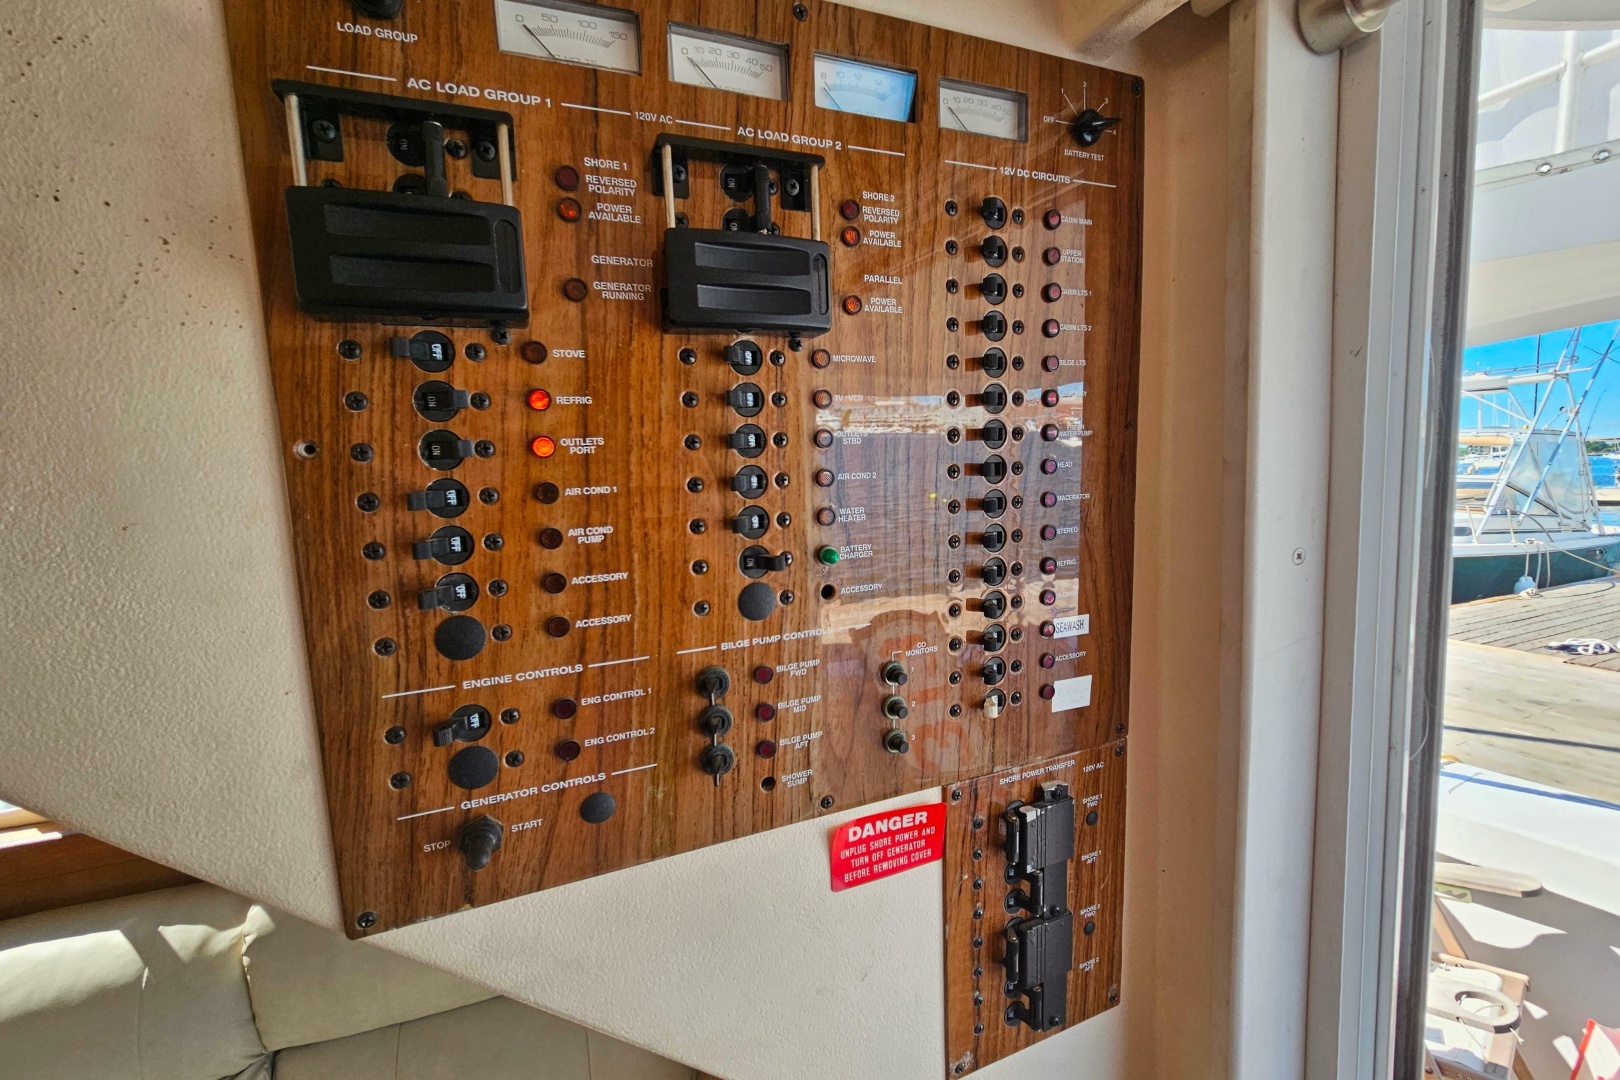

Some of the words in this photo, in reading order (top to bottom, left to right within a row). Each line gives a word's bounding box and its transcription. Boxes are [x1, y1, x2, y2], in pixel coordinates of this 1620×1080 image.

[337, 21, 372, 36] LOAD
[375, 28, 418, 43] GROUP
[542, 13, 558, 23] 50
[578, 20, 597, 30] 100
[609, 31, 628, 41] 150
[694, 46, 705, 54] 10
[708, 47, 722, 56] 20
[727, 51, 740, 60] 30
[746, 58, 758, 66] 40
[760, 64, 773, 72] 50
[407, 78, 431, 90] AC
[436, 81, 480, 97] LOAD
[484, 88, 541, 105] GROUP
[545, 98, 552, 108] 1
[635, 111, 657, 122] 120V
[659, 115, 673, 124] AC
[1043, 116, 1055, 124] OFF
[737, 126, 755, 138] AC
[758, 130, 789, 143] LOAD
[792, 135, 833, 148] GROUP
[835, 141, 842, 150] 2
[1064, 149, 1090, 159] BATTERY
[1091, 153, 1104, 161] TEST
[584, 157, 621, 170] SHORE
[623, 162, 628, 171] 1
[1000, 166, 1015, 176] 12V
[1017, 169, 1030, 178] DC
[1032, 171, 1071, 184] CIRCUITS
[586, 174, 637, 188] REVERSED
[728, 178, 736, 188] ON
[588, 184, 636, 197] POLARITY
[863, 191, 889, 202] SHORE
[597, 202, 633, 214] POWER
[863, 206, 900, 217] REVERSED
[589, 212, 642, 224] AVAILABLE
[864, 214, 899, 225] POLARITY
[1061, 216, 1078, 224] CABIN
[1079, 218, 1093, 226] MAIN
[870, 230, 896, 239] POWER
[863, 238, 902, 248] AVAILABLE
[1063, 249, 1081, 257] UPPER
[591, 255, 654, 268] GENERATOR
[1061, 256, 1084, 264] STATION
[864, 275, 902, 284] PARALLEL
[593, 281, 652, 293] GENERATOR
[1060, 288, 1077, 296] CABIN
[602, 291, 645, 301] RUNNING
[871, 298, 896, 306] POWER
[865, 305, 903, 314] AVAILABLE
[432, 344, 442, 360] OFF
[553, 349, 586, 358] STOVE
[745, 350, 753, 366] OFF
[833, 355, 877, 363] MICROWAVE
[428, 396, 436, 407] ON
[556, 396, 593, 405] REFRIG
[560, 437, 605, 446] OUTLETS
[748, 434, 756, 448] OFF
[432, 446, 440, 456] ON
[570, 446, 597, 455] PORT
[565, 488, 582, 496] AIR
[583, 486, 611, 495] COND
[446, 490, 457, 506] OFF
[1057, 493, 1090, 501] MACERATOR
[840, 507, 865, 515] WATER
[839, 514, 866, 522] HEATER
[568, 528, 584, 537] AIR
[586, 526, 614, 535] COND
[1057, 527, 1078, 535] STEREO
[451, 537, 462, 552] OFF
[578, 535, 605, 544] PUMP
[841, 544, 872, 553] BATTERY
[840, 551, 874, 560] CHARGER
[1057, 559, 1076, 567] REFRIG
[572, 572, 628, 585] ACCESSORY
[456, 584, 466, 600] OFF
[841, 583, 883, 594] ACCESSORY
[575, 614, 632, 628] ACCESSORY
[1056, 619, 1084, 634] SEAWASH
[721, 639, 750, 651] BILGE
[753, 635, 781, 645] PUMP
[783, 627, 833, 641] CONTROLS
[906, 646, 938, 657] MONITORS
[1056, 651, 1087, 662] ACCESSORY
[776, 663, 798, 673] BILGE
[800, 659, 821, 668] PUMP
[463, 674, 513, 689] ENGINE
[515, 664, 584, 681] CONTROLS
[790, 668, 807, 678] FWD
[581, 696, 601, 706] ENG
[603, 689, 646, 702] CONTROL
[778, 699, 800, 710] BILGE
[801, 695, 822, 705] PUMP
[794, 705, 806, 714] MID
[585, 737, 604, 747] ENG
[606, 729, 649, 744] CONTROL
[780, 736, 802, 746] BILGE
[802, 731, 823, 742] PUMP
[795, 741, 809, 750] AFT
[1096, 762, 1105, 770] AC
[782, 769, 813, 782] SHOWER
[1000, 775, 1021, 785] SHORE
[1022, 768, 1045, 780] POWER
[1046, 760, 1076, 773] TRANSFER
[788, 778, 808, 788] SUMP
[460, 787, 538, 810] GENERATOR
[541, 772, 606, 793] CONTROLS
[1083, 795, 1100, 804] SHORE
[511, 819, 543, 833] START
[848, 811, 928, 843] DANGER
[424, 840, 451, 853] STOP
[841, 844, 866, 859] UNPLUG
[870, 837, 892, 851] SHORE
[895, 830, 918, 843] POWER
[922, 826, 936, 836] AND
[851, 855, 869, 868] TURN
[872, 851, 884, 862] OFF
[887, 839, 926, 858] GENERATOR
[844, 868, 870, 883] BEFORE
[874, 856, 908, 874] REMOVING
[911, 849, 932, 862] COVER
